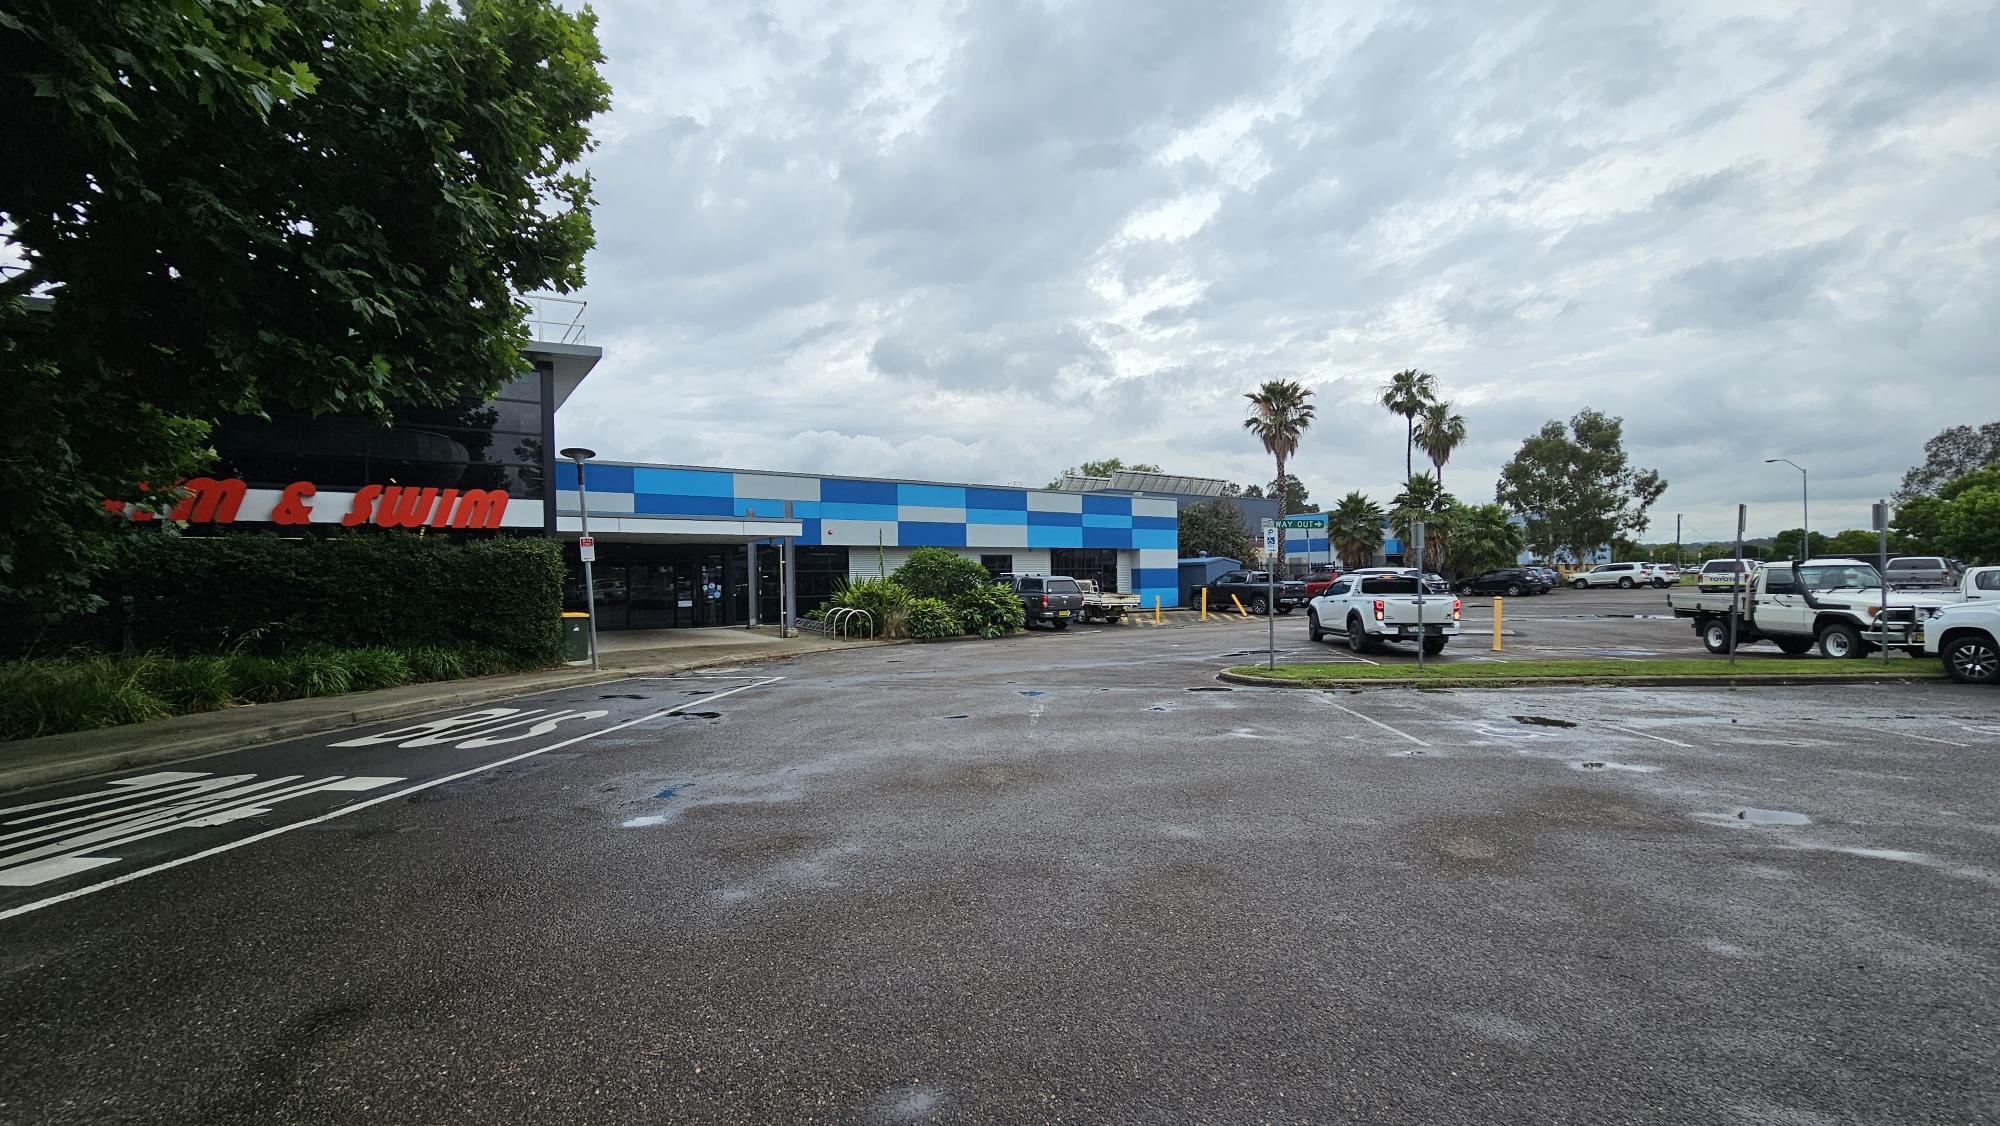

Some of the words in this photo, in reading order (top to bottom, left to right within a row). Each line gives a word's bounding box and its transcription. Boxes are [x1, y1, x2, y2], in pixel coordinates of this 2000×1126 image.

[271, 481, 316, 525] &
[341, 484, 510, 529] SWIM
[1275, 520, 1293, 528] WAY
[1297, 520, 1314, 528] OUT
[327, 708, 609, 749] BUS
